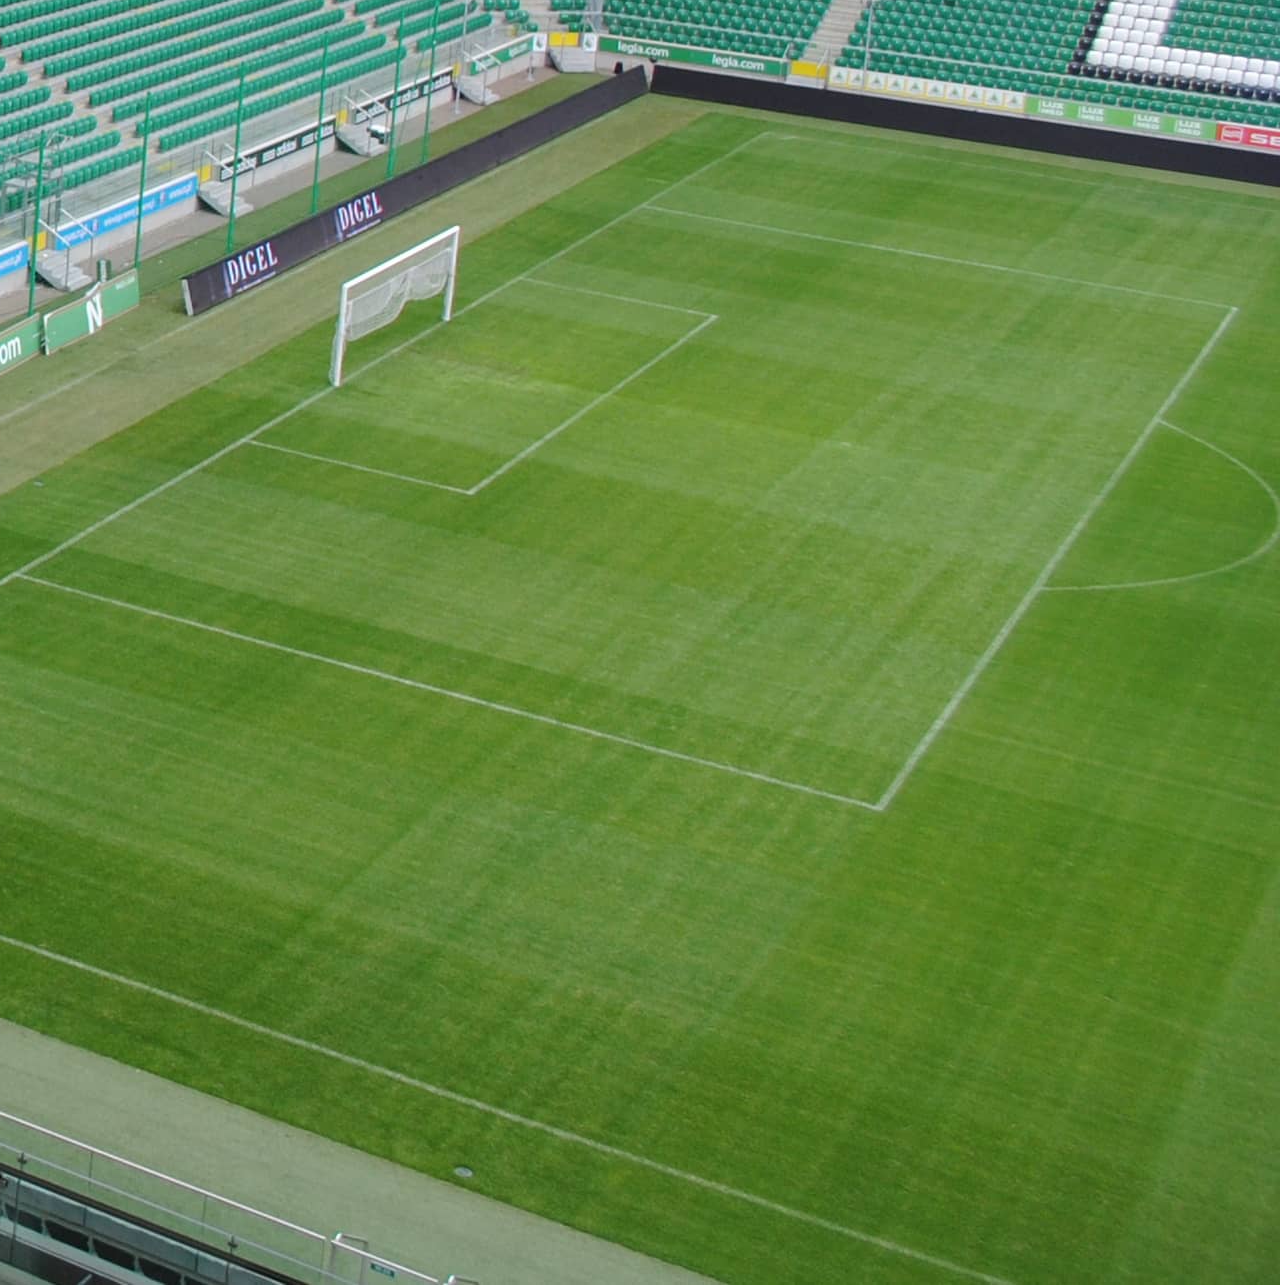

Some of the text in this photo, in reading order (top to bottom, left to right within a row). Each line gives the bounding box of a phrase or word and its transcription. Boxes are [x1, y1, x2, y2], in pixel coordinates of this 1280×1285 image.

[618, 41, 669, 58] legia.com
[712, 54, 765, 71] legia.com
[1042, 100, 1064, 110] LUX
[1081, 105, 1104, 115] LUX
[1136, 114, 1160, 124] LUX
[1178, 119, 1201, 129] LUX
[337, 191, 383, 231] DIGEL
[227, 241, 278, 285] DIGEL
